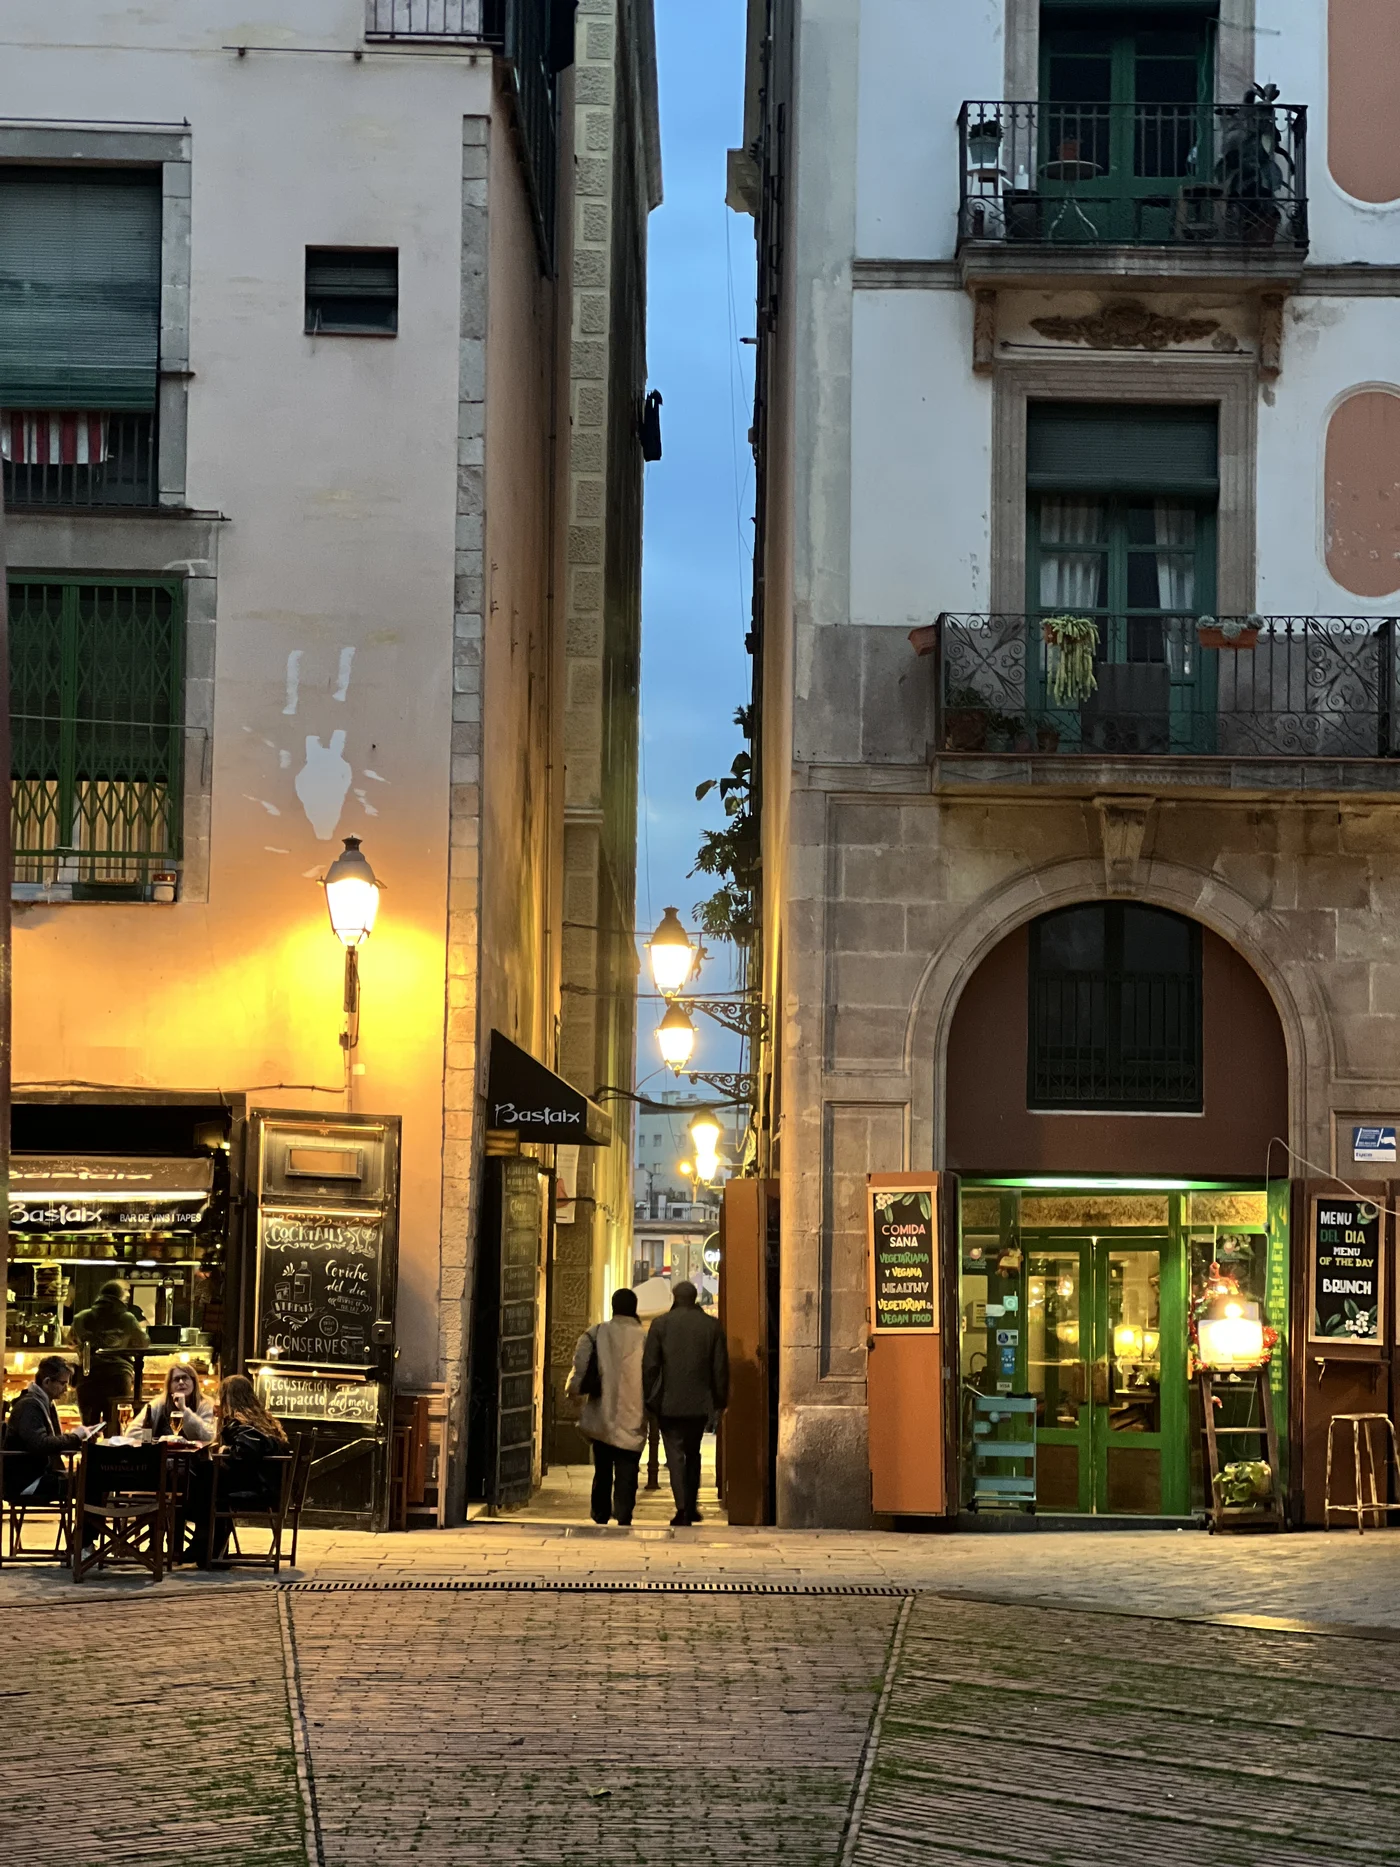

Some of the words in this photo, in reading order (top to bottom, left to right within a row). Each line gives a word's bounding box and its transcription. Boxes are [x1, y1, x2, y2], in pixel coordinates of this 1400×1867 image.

[495, 1102, 580, 1127] Bastaix
[9, 1202, 103, 1225] Bastaix
[120, 1213, 137, 1223] BAR
[138, 1213, 150, 1223] DE
[151, 1213, 170, 1223] VINS
[176, 1213, 202, 1223] TAPES
[1320, 1211, 1352, 1225] MENU
[271, 1226, 344, 1243] COCKTAILS
[881, 1224, 926, 1235] COMIDA
[889, 1236, 918, 1247] SANA
[1320, 1229, 1340, 1243] DEL
[1345, 1230, 1366, 1244] DIA
[879, 1251, 929, 1264] VEGETARIANA
[1333, 1247, 1360, 1256] MENU
[1319, 1257, 1332, 1266] OF
[1335, 1257, 1354, 1267] THE
[1355, 1259, 1374, 1268] DAY
[885, 1269, 890, 1277] Y
[892, 1266, 922, 1278] VEGANA
[324, 1280, 344, 1293] del
[881, 1282, 929, 1294] HEALTHY
[1322, 1278, 1372, 1295] BRUNCH
[877, 1297, 926, 1312] VEGETARIAN
[881, 1313, 909, 1324] VEGAN
[912, 1313, 931, 1323] FOOD
[275, 1334, 348, 1355] CONSERVES
[264, 1379, 331, 1392] DEGUSTACIÓN
[270, 1394, 325, 1411] carpaccio
